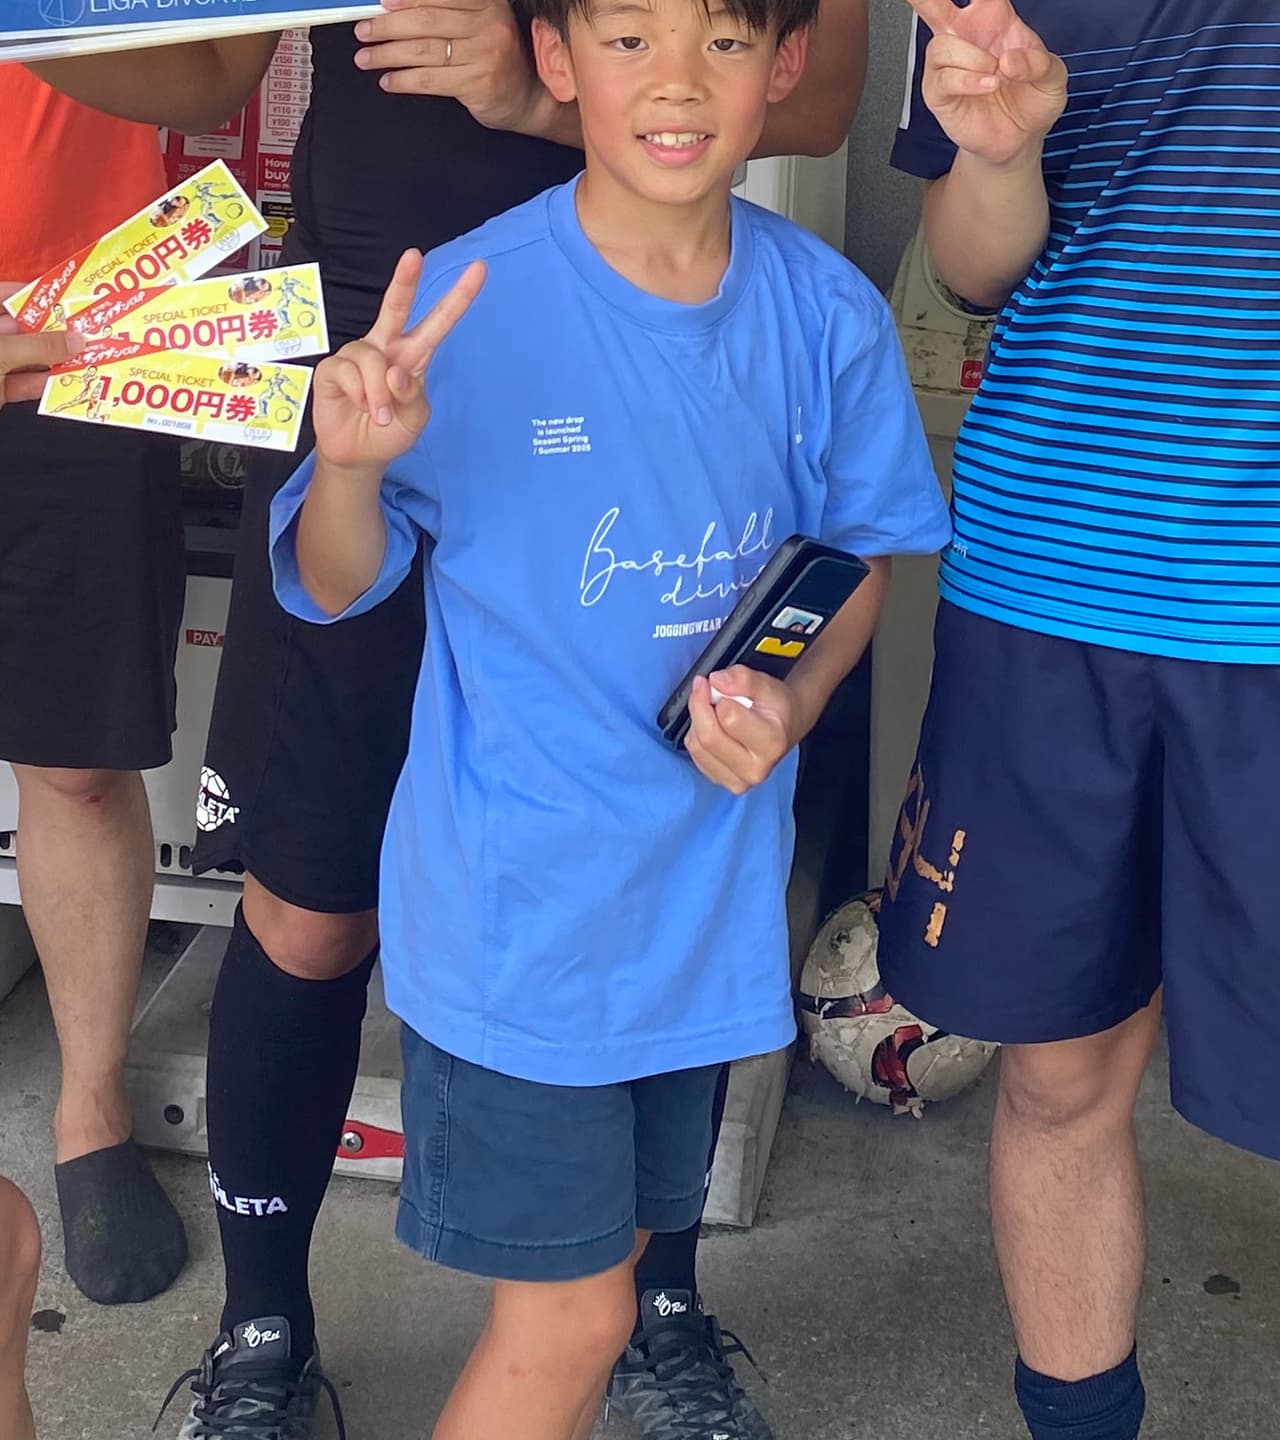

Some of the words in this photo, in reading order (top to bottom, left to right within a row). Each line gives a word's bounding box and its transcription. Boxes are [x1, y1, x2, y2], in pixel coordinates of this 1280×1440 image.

[265, 158, 290, 168] How
[265, 168, 290, 182] buy
[84, 257, 125, 286] SPECIAL
[123, 232, 160, 259] TICKET
[143, 311, 187, 325] SPECIAL
[188, 303, 228, 318] TICKET
[129, 367, 173, 383] SPECIAL
[176, 374, 216, 388] TICKET
[98, 375, 257, 423] 1,000円券
[531, 419, 546, 427] The
[192, 632, 220, 646] PAY
